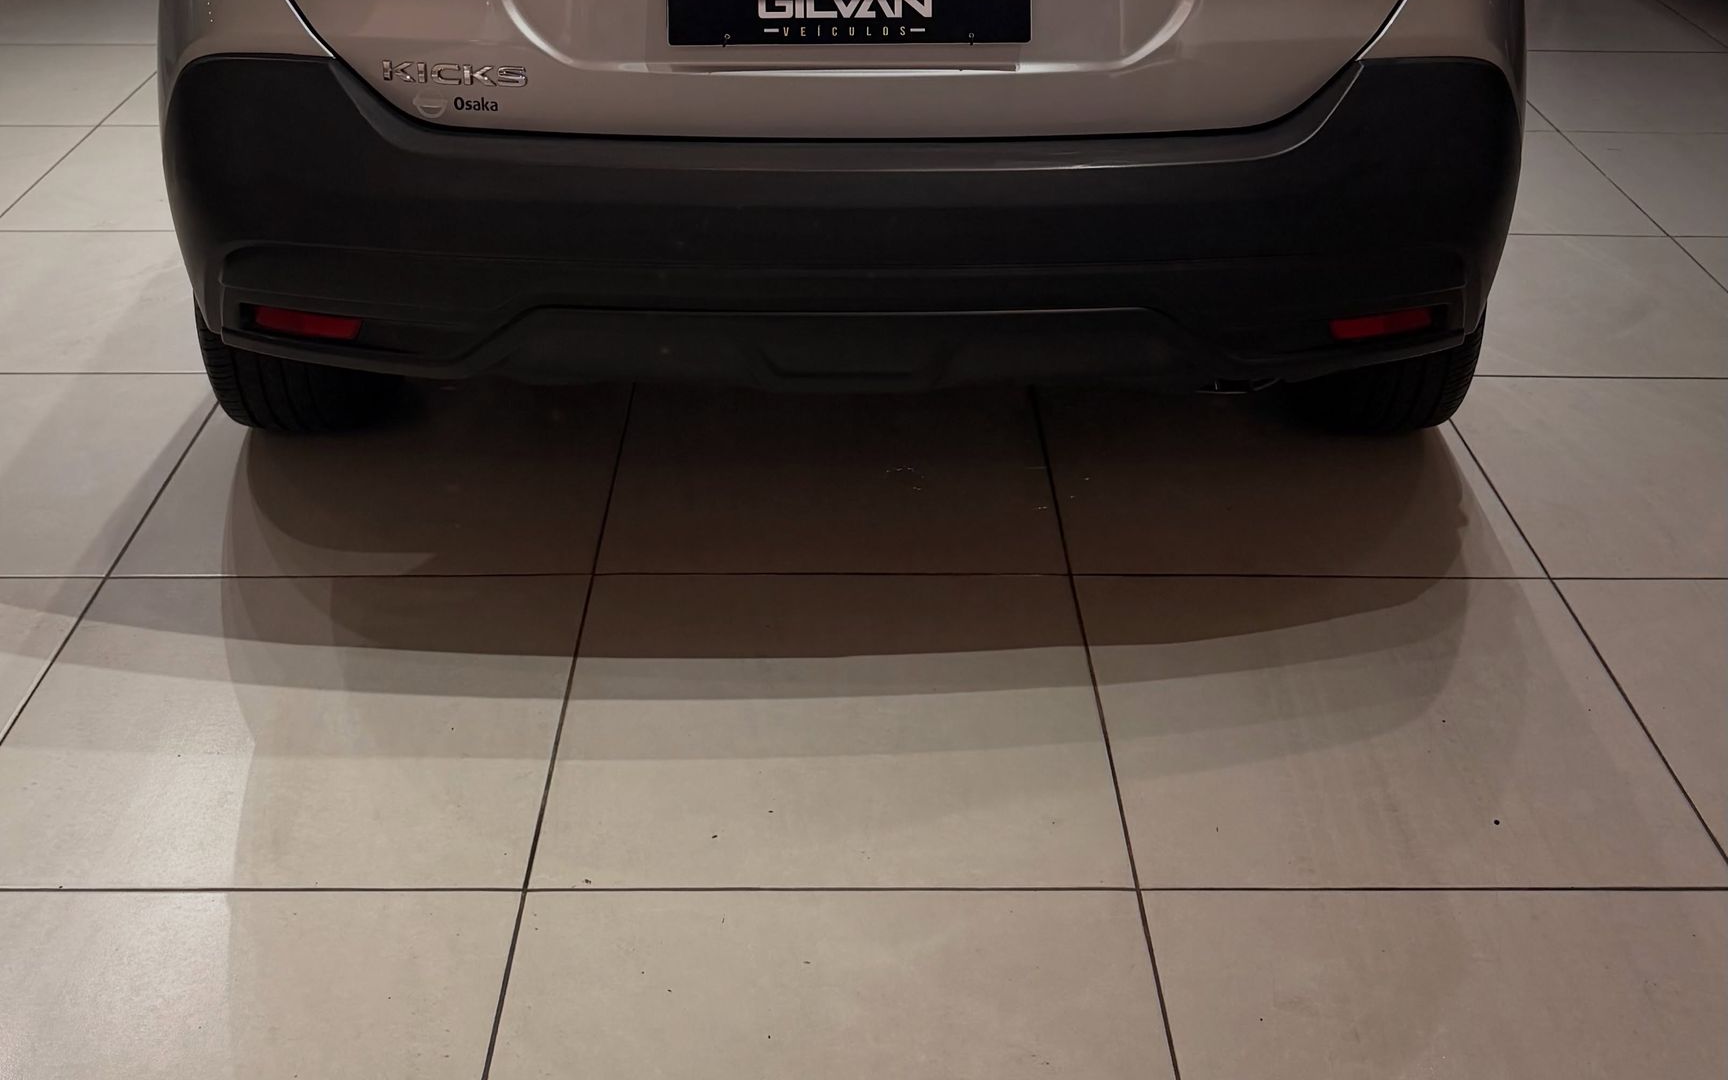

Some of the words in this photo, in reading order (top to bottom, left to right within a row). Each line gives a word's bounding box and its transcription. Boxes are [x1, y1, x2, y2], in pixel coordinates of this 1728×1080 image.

[783, 24, 906, 38] VEÍCULOS
[382, 59, 529, 88] KICKS
[453, 96, 499, 112] Osaka
